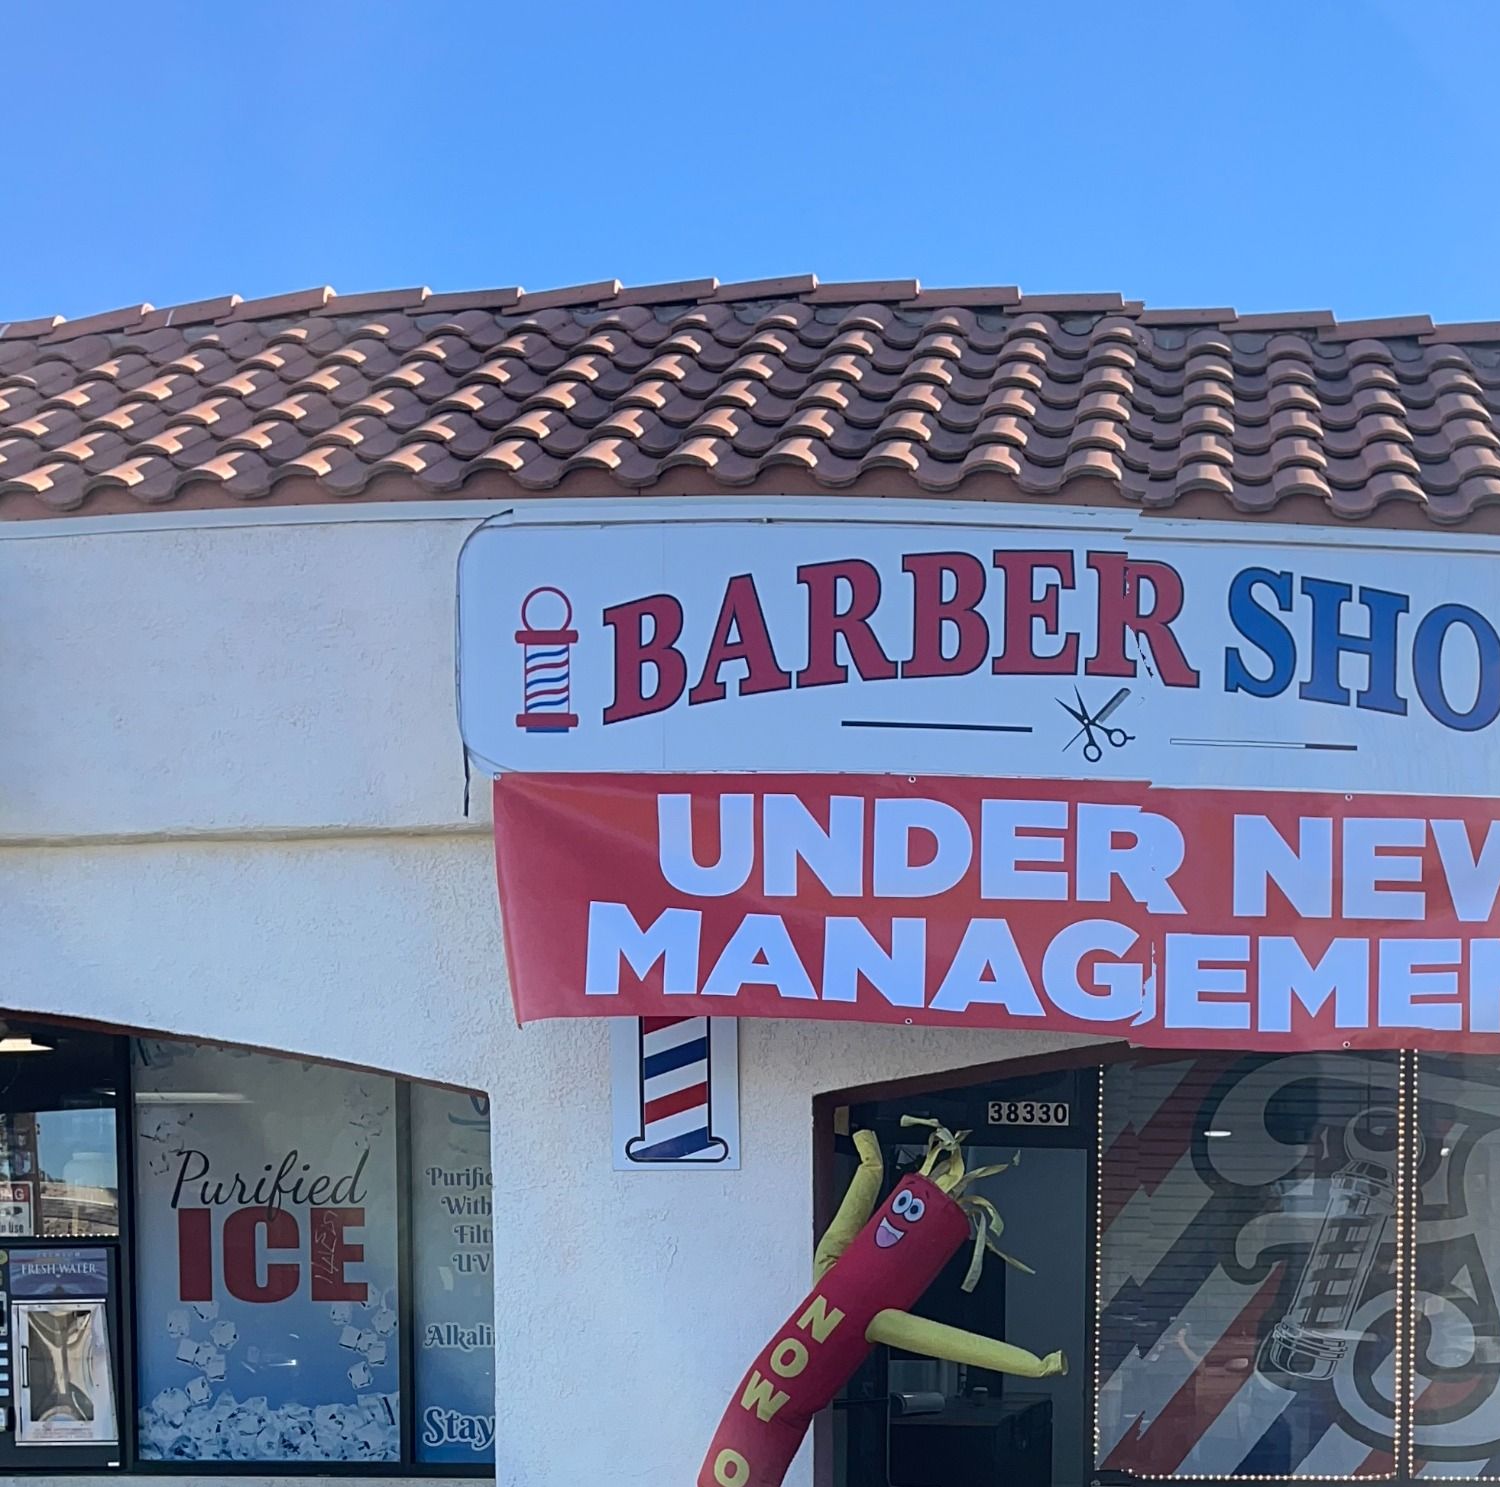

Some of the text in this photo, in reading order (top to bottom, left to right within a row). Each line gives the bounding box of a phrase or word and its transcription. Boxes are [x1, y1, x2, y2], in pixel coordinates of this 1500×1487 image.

[602, 549, 1200, 725] BARBER
[656, 793, 1188, 915] UNDER
[989, 1102, 1069, 1125] 38330
[170, 1148, 370, 1222] Purified
[22, 1262, 97, 1275] FRESH WATER
[178, 1206, 369, 1304] ICE
[424, 1323, 495, 1350] Alkali
[740, 1295, 846, 1423] NOW
